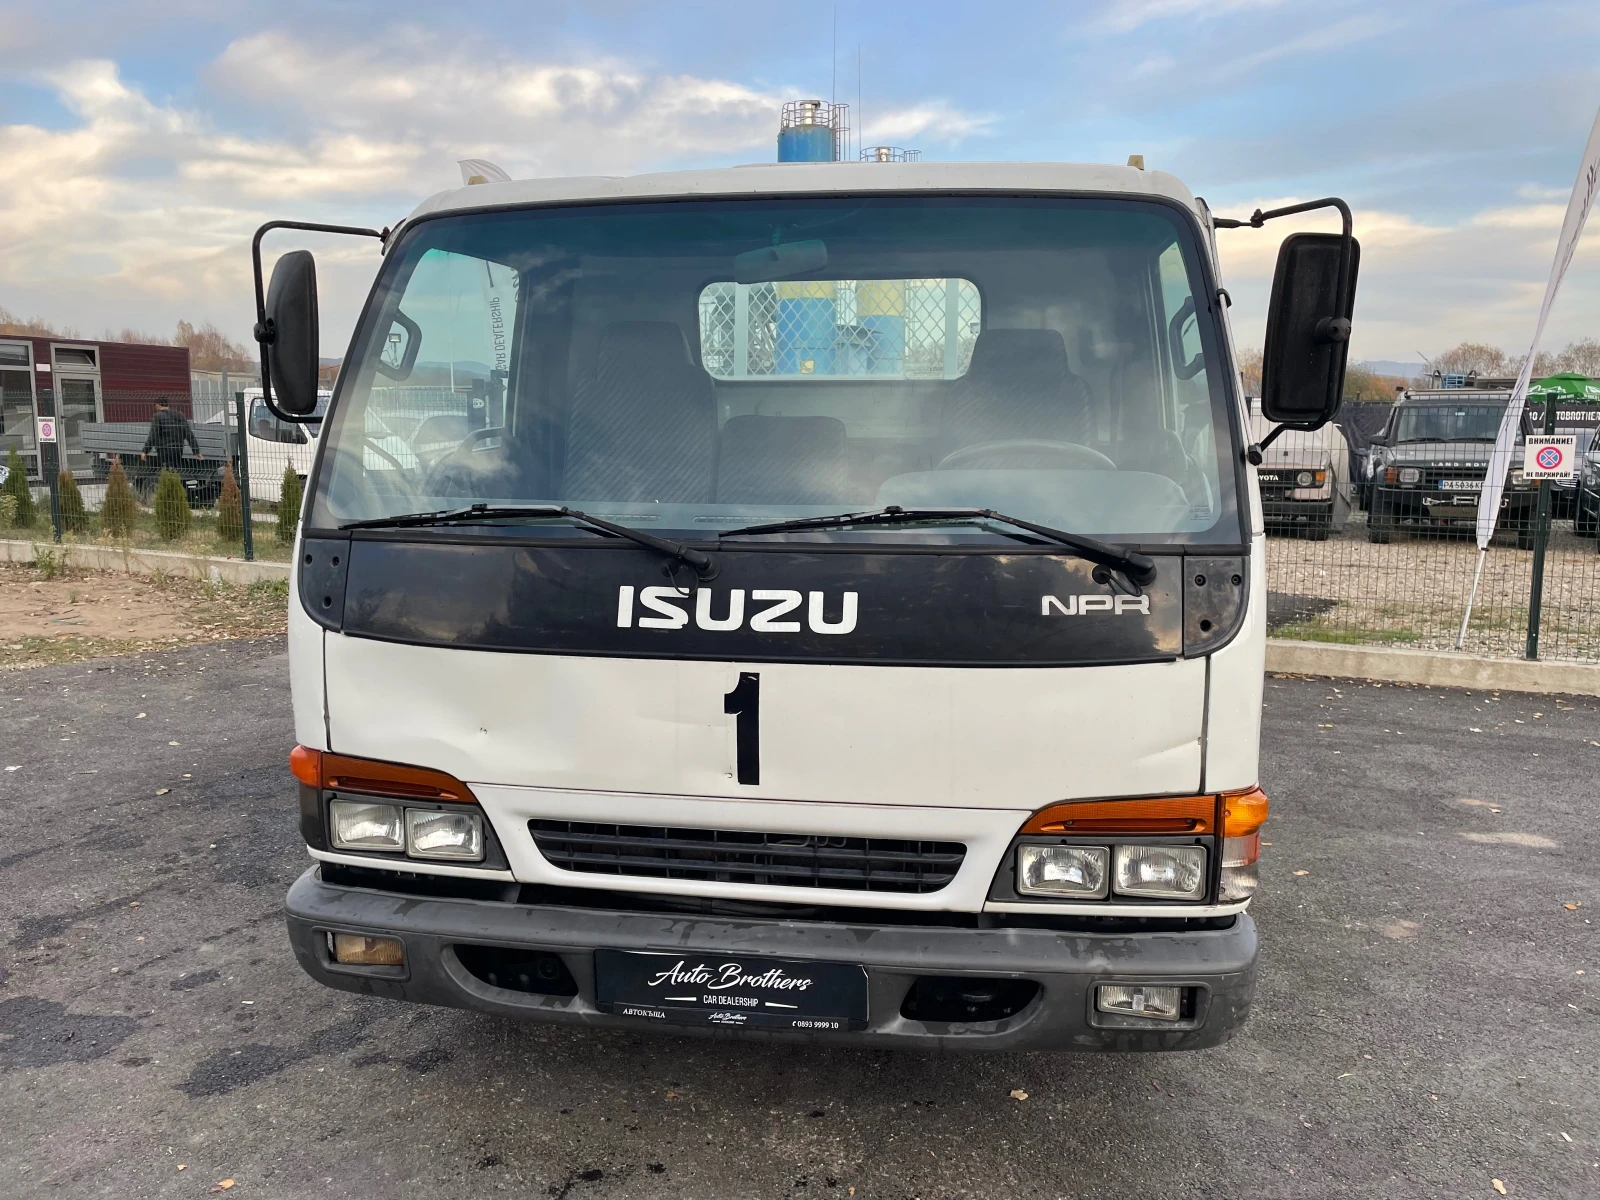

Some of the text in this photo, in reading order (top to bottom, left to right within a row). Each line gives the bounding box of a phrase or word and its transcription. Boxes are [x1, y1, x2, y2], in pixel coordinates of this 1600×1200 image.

[1528, 437, 1574, 445] ВНИМАНИЕ!
[1534, 470, 1571, 478] ПАРКИРАЙ!
[617, 585, 859, 635] ISUZU
[1041, 594, 1151, 616] NPR
[724, 671, 760, 786] 1
[647, 960, 813, 991] Auto Brothers
[703, 994, 759, 1007] CAR DEALERSHIP
[622, 1008, 666, 1019] АВТОКЪЩА
[797, 1020, 813, 1028] 0893
[813, 1021, 830, 1029] 9999
